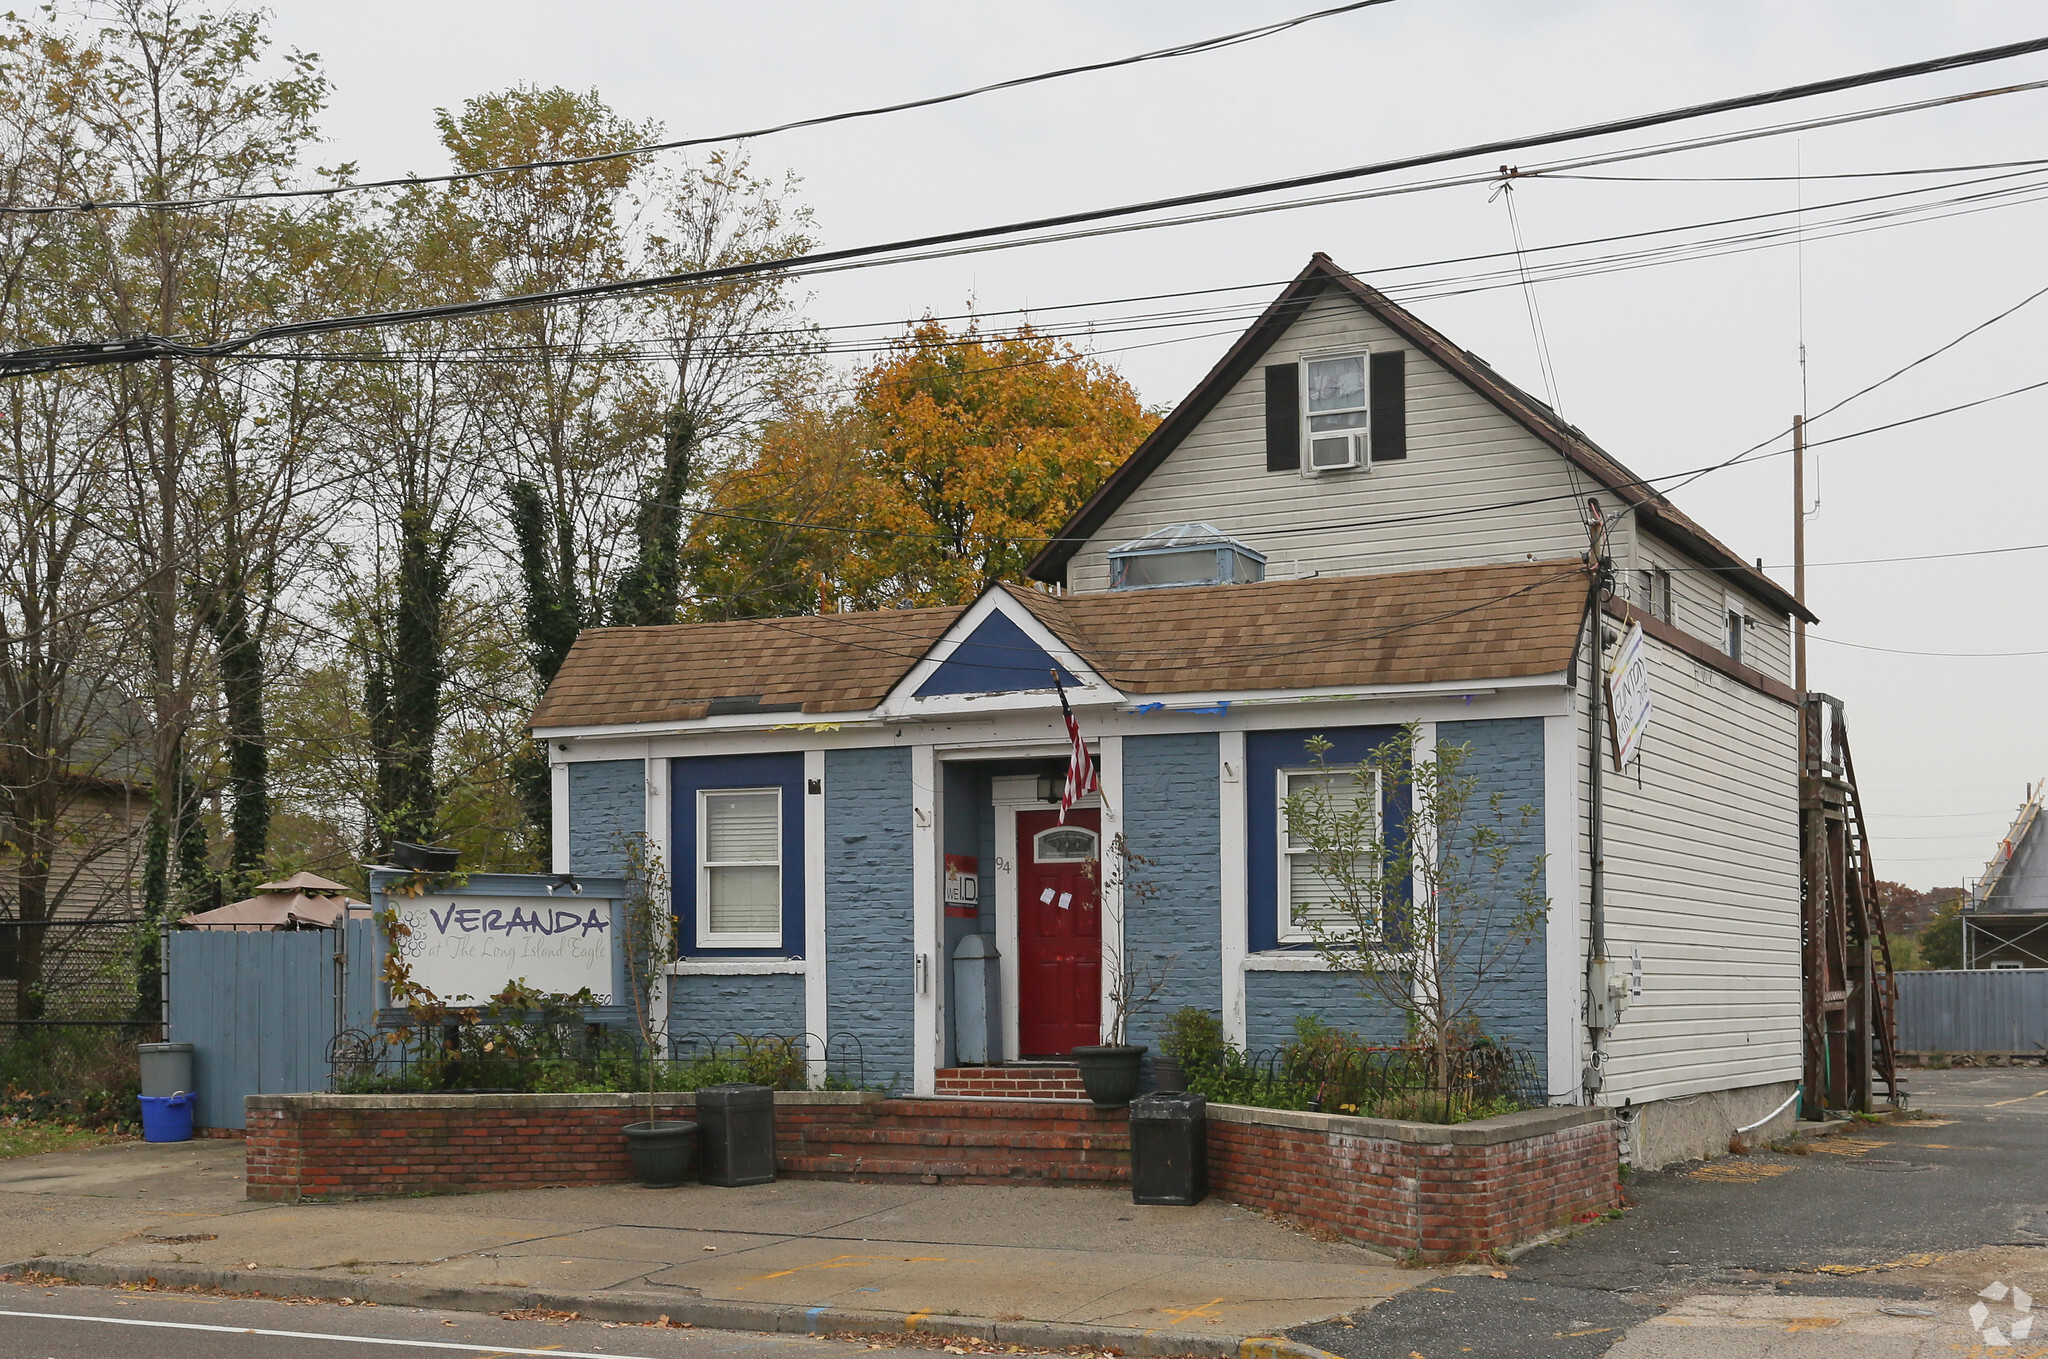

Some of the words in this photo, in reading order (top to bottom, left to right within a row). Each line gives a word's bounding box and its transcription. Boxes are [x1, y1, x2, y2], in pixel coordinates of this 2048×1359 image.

[996, 857, 1011, 874] 94
[947, 888, 958, 900] WE
[430, 902, 609, 937] VERANDA
[429, 943, 442, 957] at
[446, 935, 475, 959] The
[481, 937, 516, 969] Long
[522, 936, 562, 959] Island
[567, 938, 605, 970] Eagle
